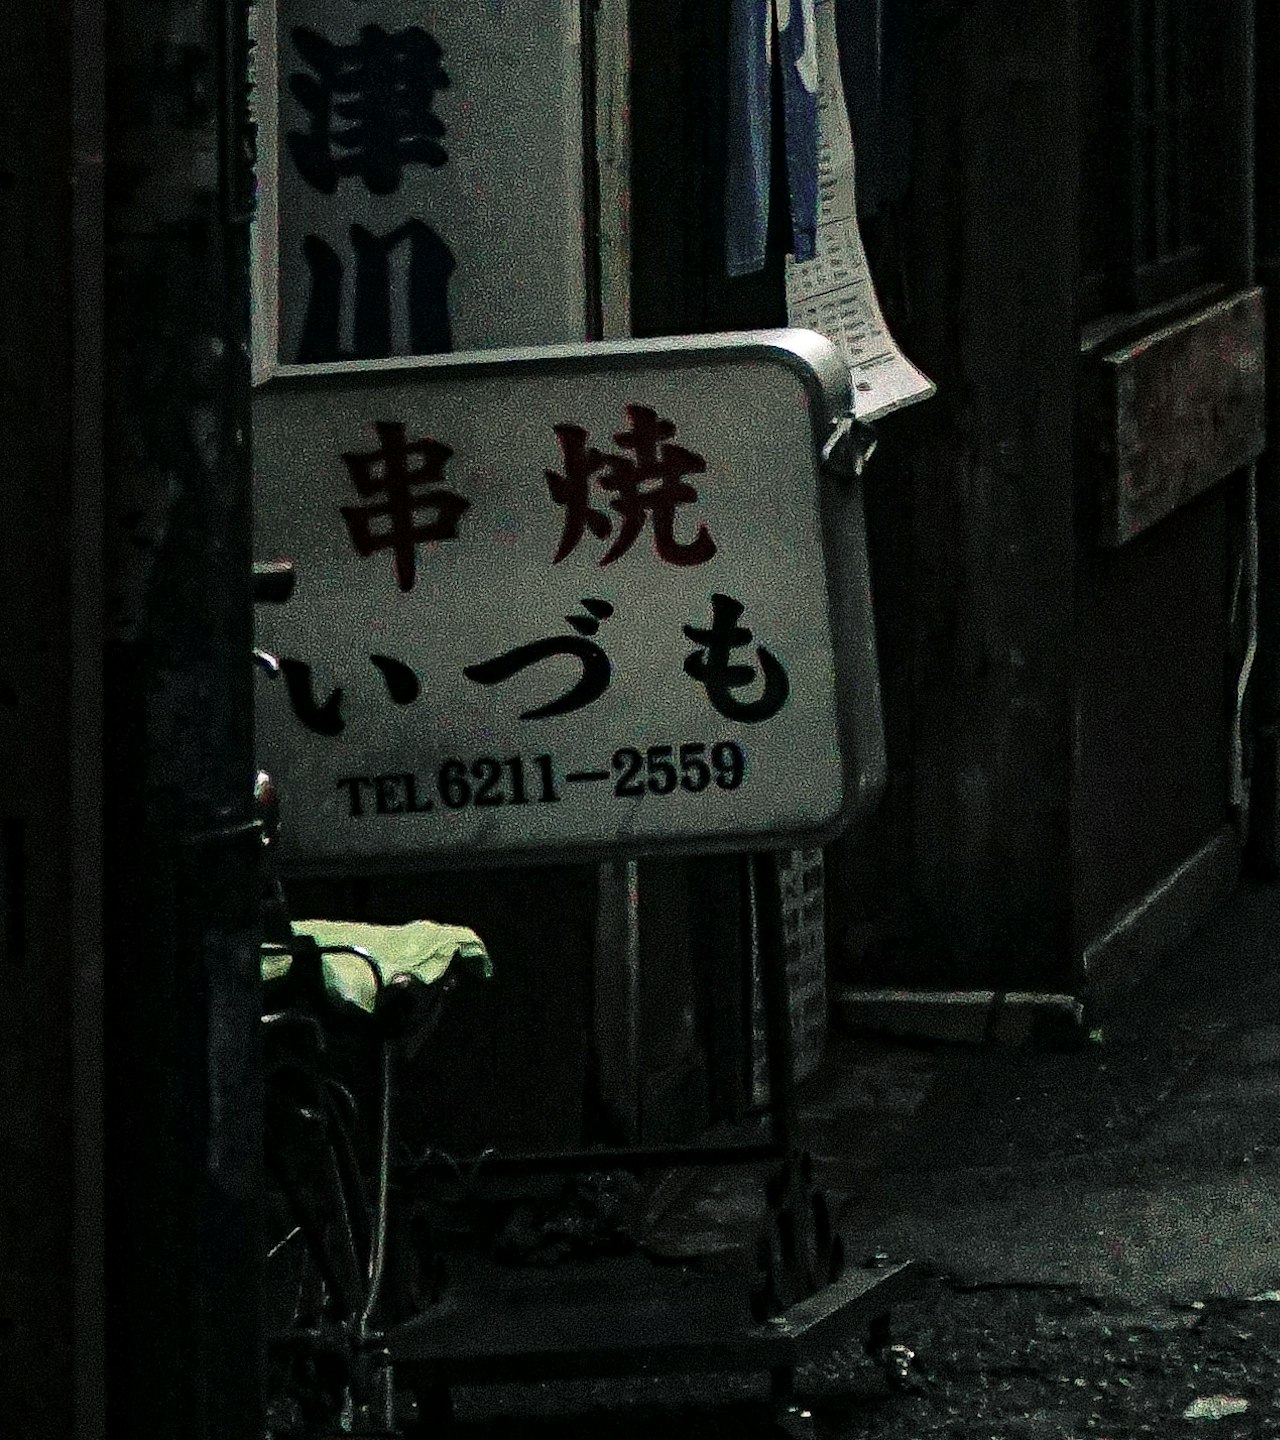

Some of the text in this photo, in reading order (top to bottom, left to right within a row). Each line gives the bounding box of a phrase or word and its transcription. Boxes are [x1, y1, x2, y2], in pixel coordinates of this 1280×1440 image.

[340, 404, 717, 592] 串焼
[278, 591, 791, 738] いづも
[337, 740, 746, 818] TEL 6211-2559
